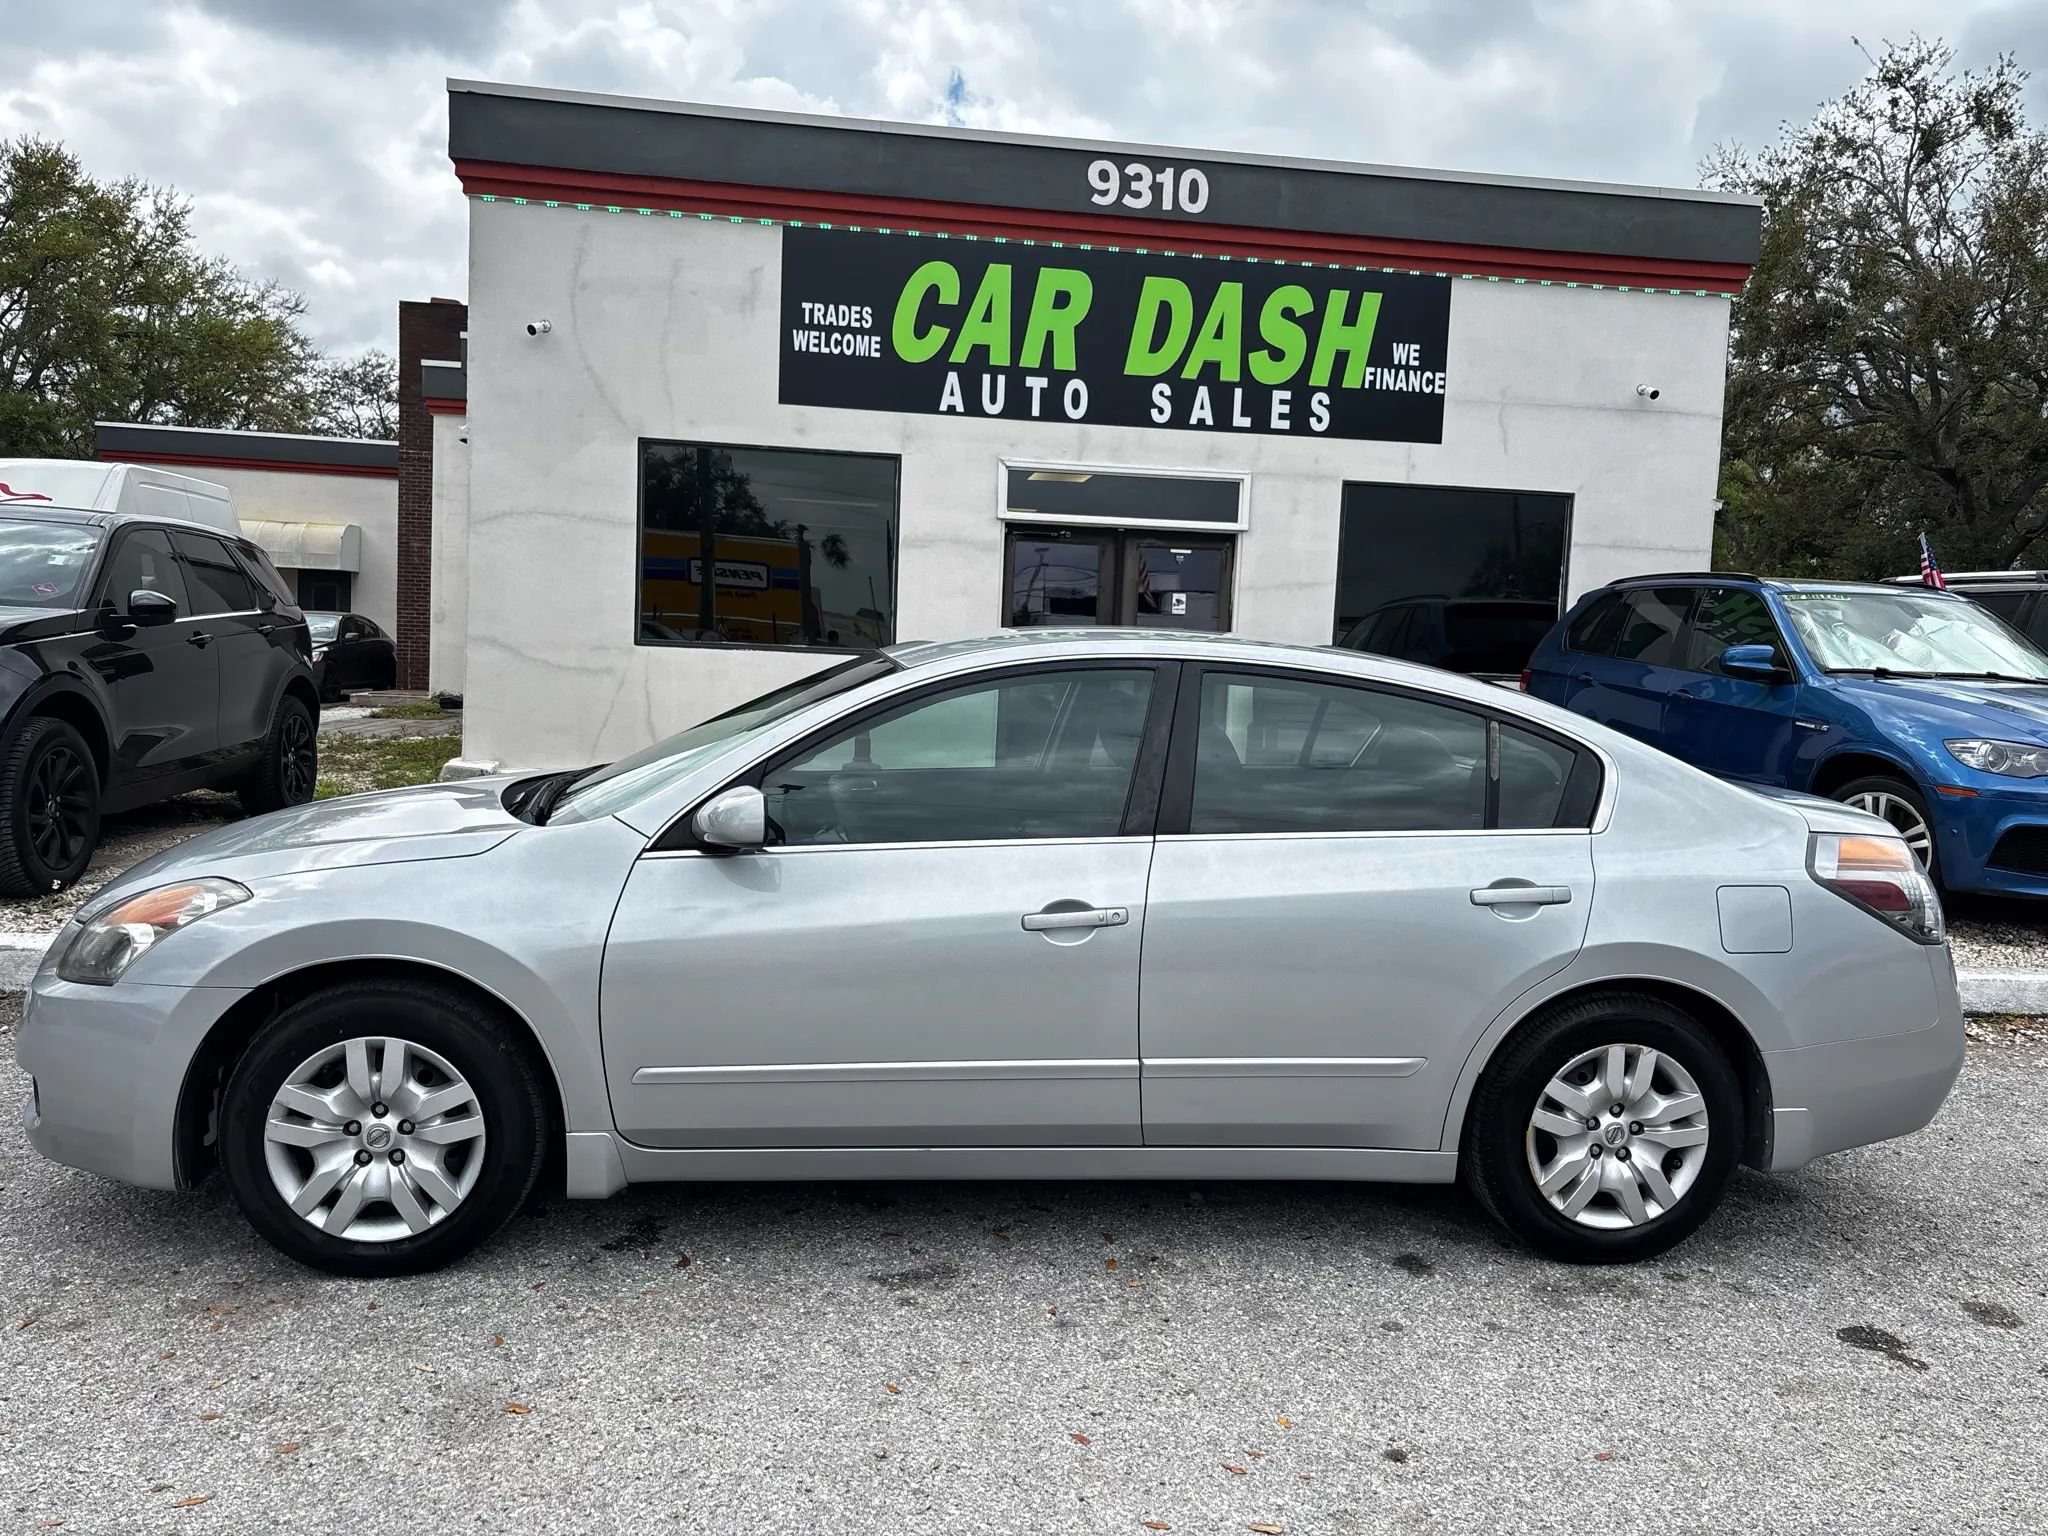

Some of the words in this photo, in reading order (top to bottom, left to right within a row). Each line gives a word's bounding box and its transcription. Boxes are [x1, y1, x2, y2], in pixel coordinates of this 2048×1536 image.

[1087, 159, 1209, 214] 9310
[801, 302, 873, 329] TRADES
[892, 260, 1094, 371] CAR
[1123, 276, 1383, 389] DASH
[792, 329, 881, 358] WELCOME
[1392, 342, 1420, 366] WE
[1364, 366, 1446, 395] FINANCE
[938, 371, 1089, 420] AUTO
[1150, 383, 1331, 433] SALES
